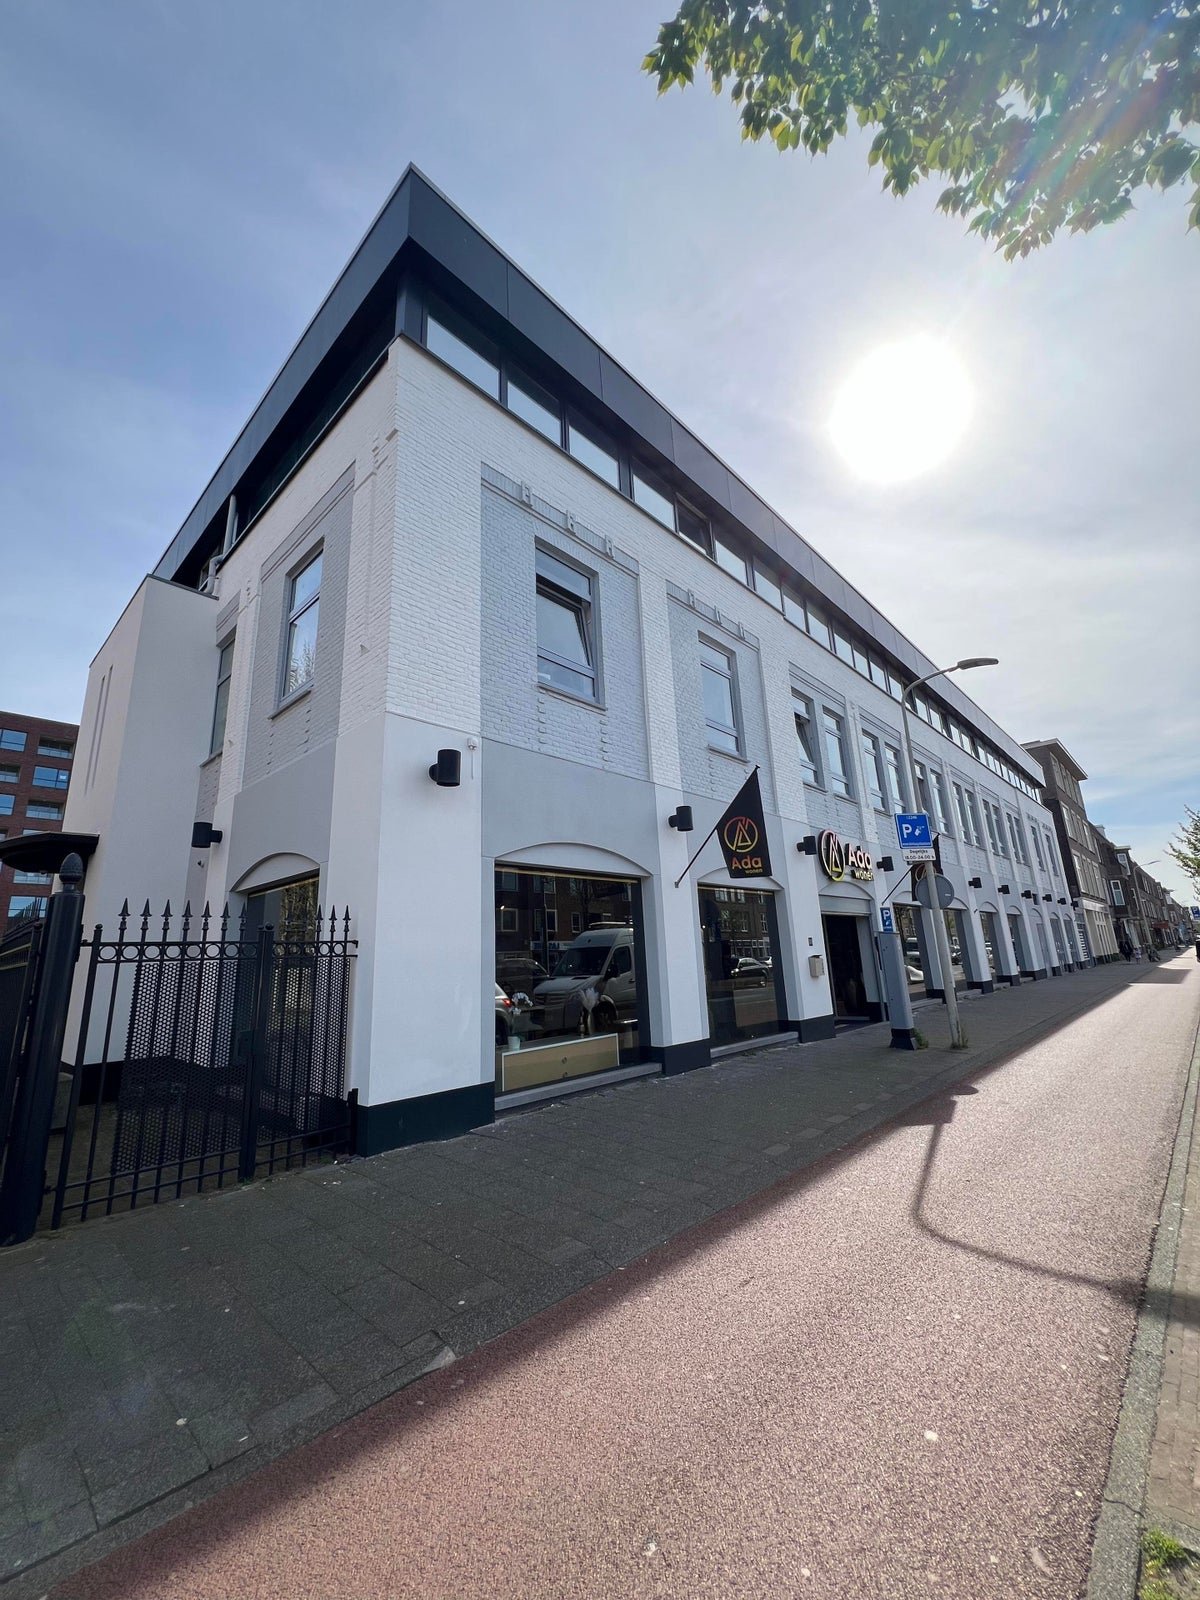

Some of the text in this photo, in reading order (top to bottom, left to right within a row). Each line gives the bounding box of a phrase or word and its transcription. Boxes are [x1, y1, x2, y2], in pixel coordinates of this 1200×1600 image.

[902, 823, 912, 838] P
[732, 855, 762, 869] Ada
[847, 843, 872, 869] Ada
[882, 910, 890, 920] P
